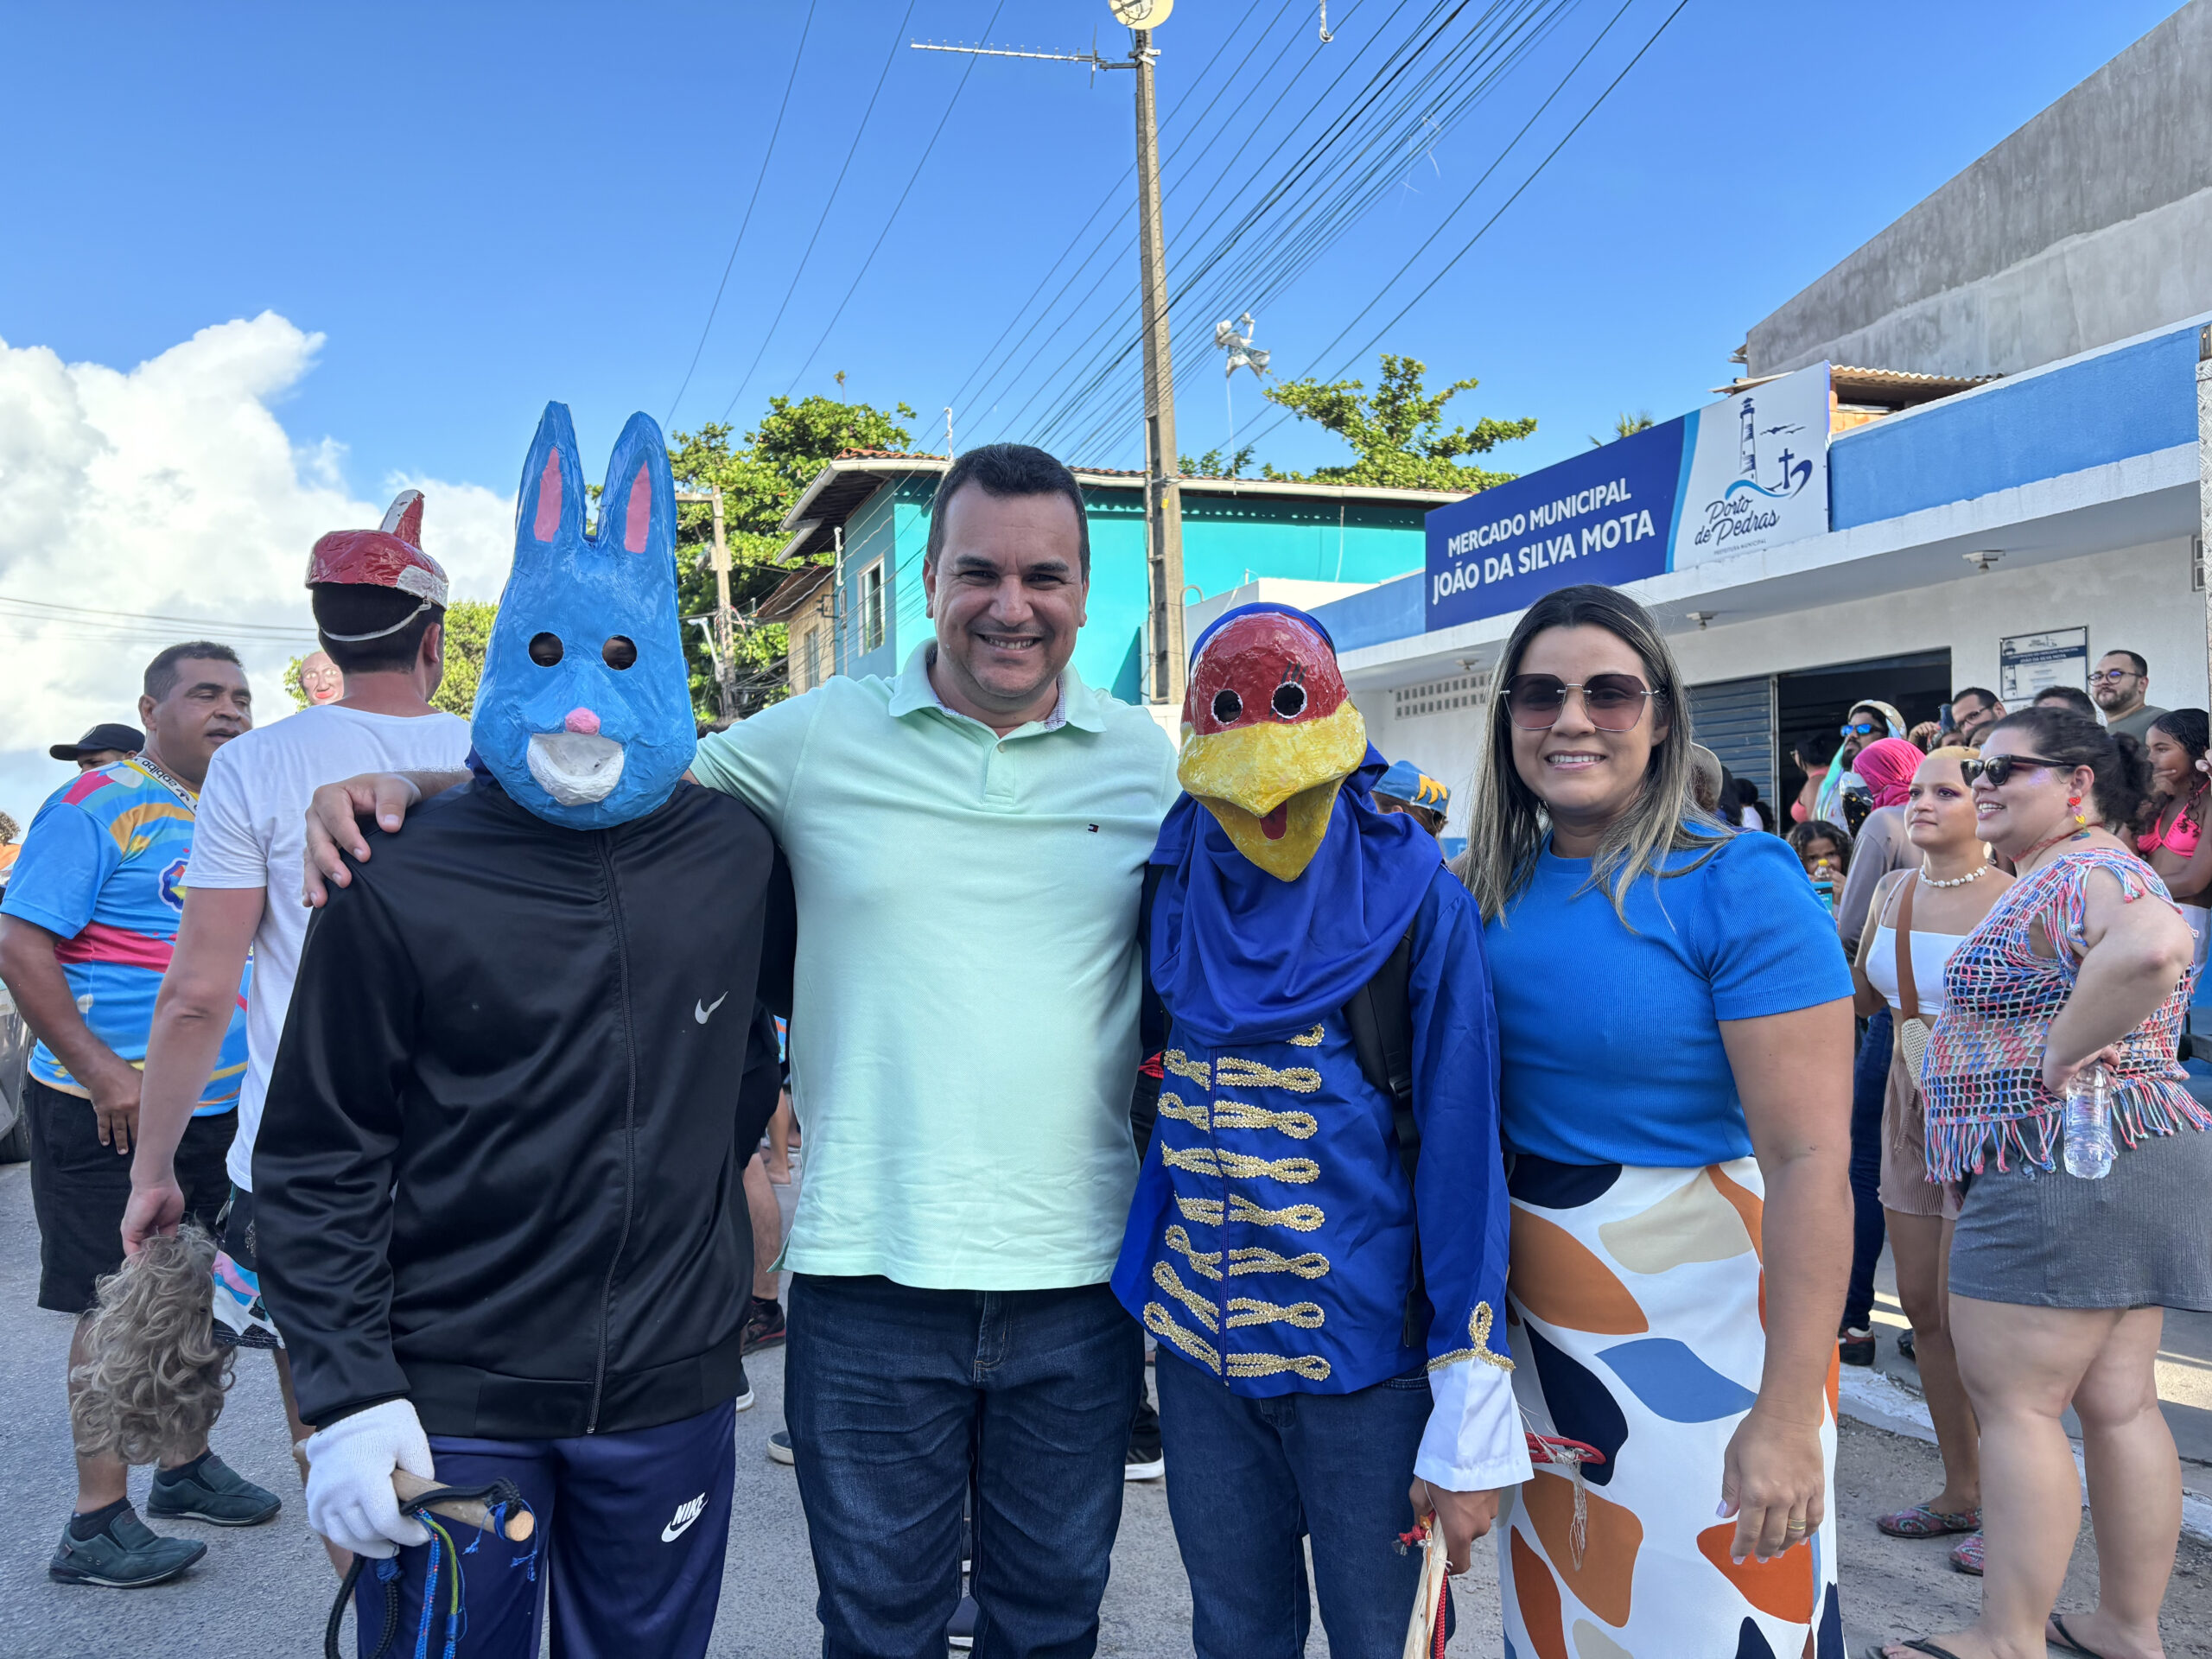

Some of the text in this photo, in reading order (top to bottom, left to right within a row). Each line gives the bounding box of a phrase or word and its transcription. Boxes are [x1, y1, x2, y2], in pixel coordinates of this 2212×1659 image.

[1448, 477, 1632, 558] MERCADO MUNICIPAL
[1694, 509, 1781, 546] de Pedras
[1705, 494, 1753, 524] Porto
[1433, 509, 1656, 606] JOÃO DA SILVA MOTA
[671, 1491, 706, 1526] NIKE
